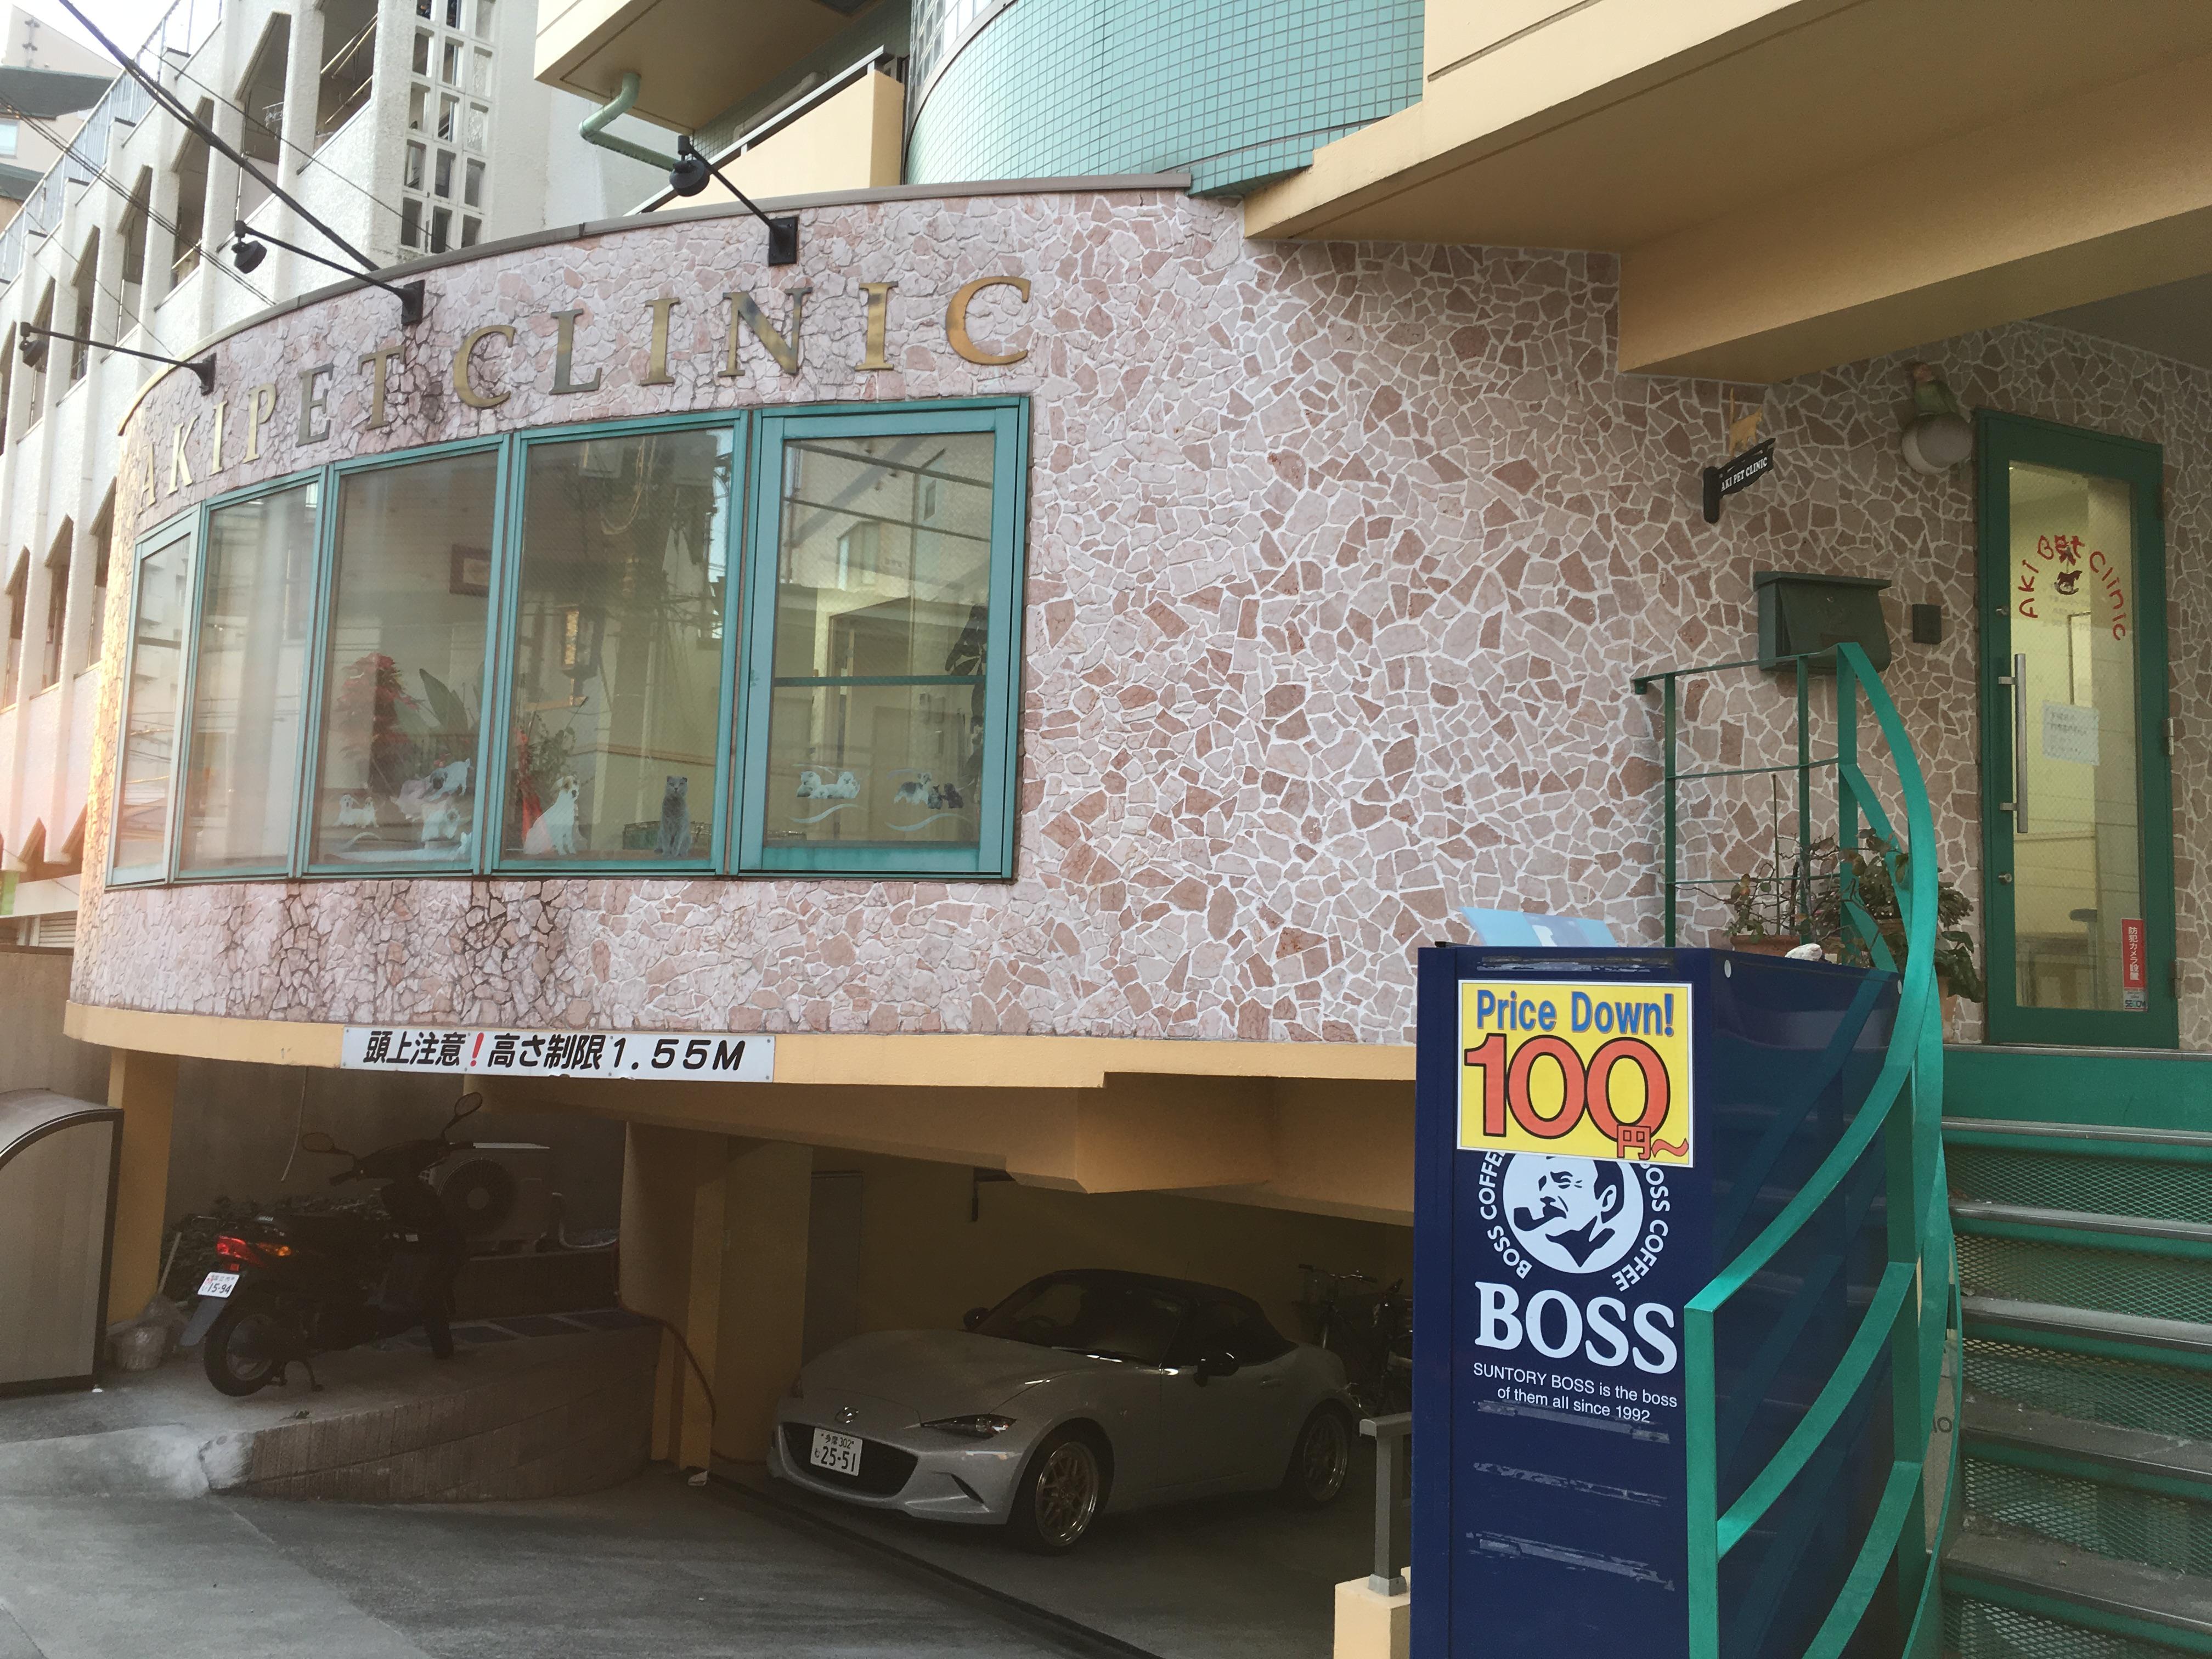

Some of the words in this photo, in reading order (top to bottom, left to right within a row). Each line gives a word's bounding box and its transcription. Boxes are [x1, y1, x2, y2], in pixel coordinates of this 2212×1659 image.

[1721, 476, 1732, 492] AKI
[1733, 469, 1745, 484] PET
[1746, 456, 1768, 477] CLINIC
[2128, 926, 2140, 980] 防犯カメラ設置
[1476, 989, 1557, 1031] Price
[1571, 991, 1674, 1037] Down!
[1639, 1163, 1671, 1212] OSS
[1487, 1226, 1532, 1279] BOSS
[1611, 1220, 1668, 1292] COFFEE
[1474, 1281, 1678, 1374] BOSS
[1474, 1362, 1547, 1385] SUNTORY
[1551, 1375, 1595, 1393] BOSS
[1599, 1382, 1611, 1396] is
[1615, 1385, 1638, 1402] the
[1643, 1389, 1678, 1408] boss
[1497, 1387, 1510, 1399] of
[1514, 1388, 1548, 1406] them
[1553, 1396, 1568, 1410] all
[1573, 1399, 1610, 1416] since
[1616, 1406, 1650, 1423] 1992
[821, 1446, 856, 1472] 25-51
